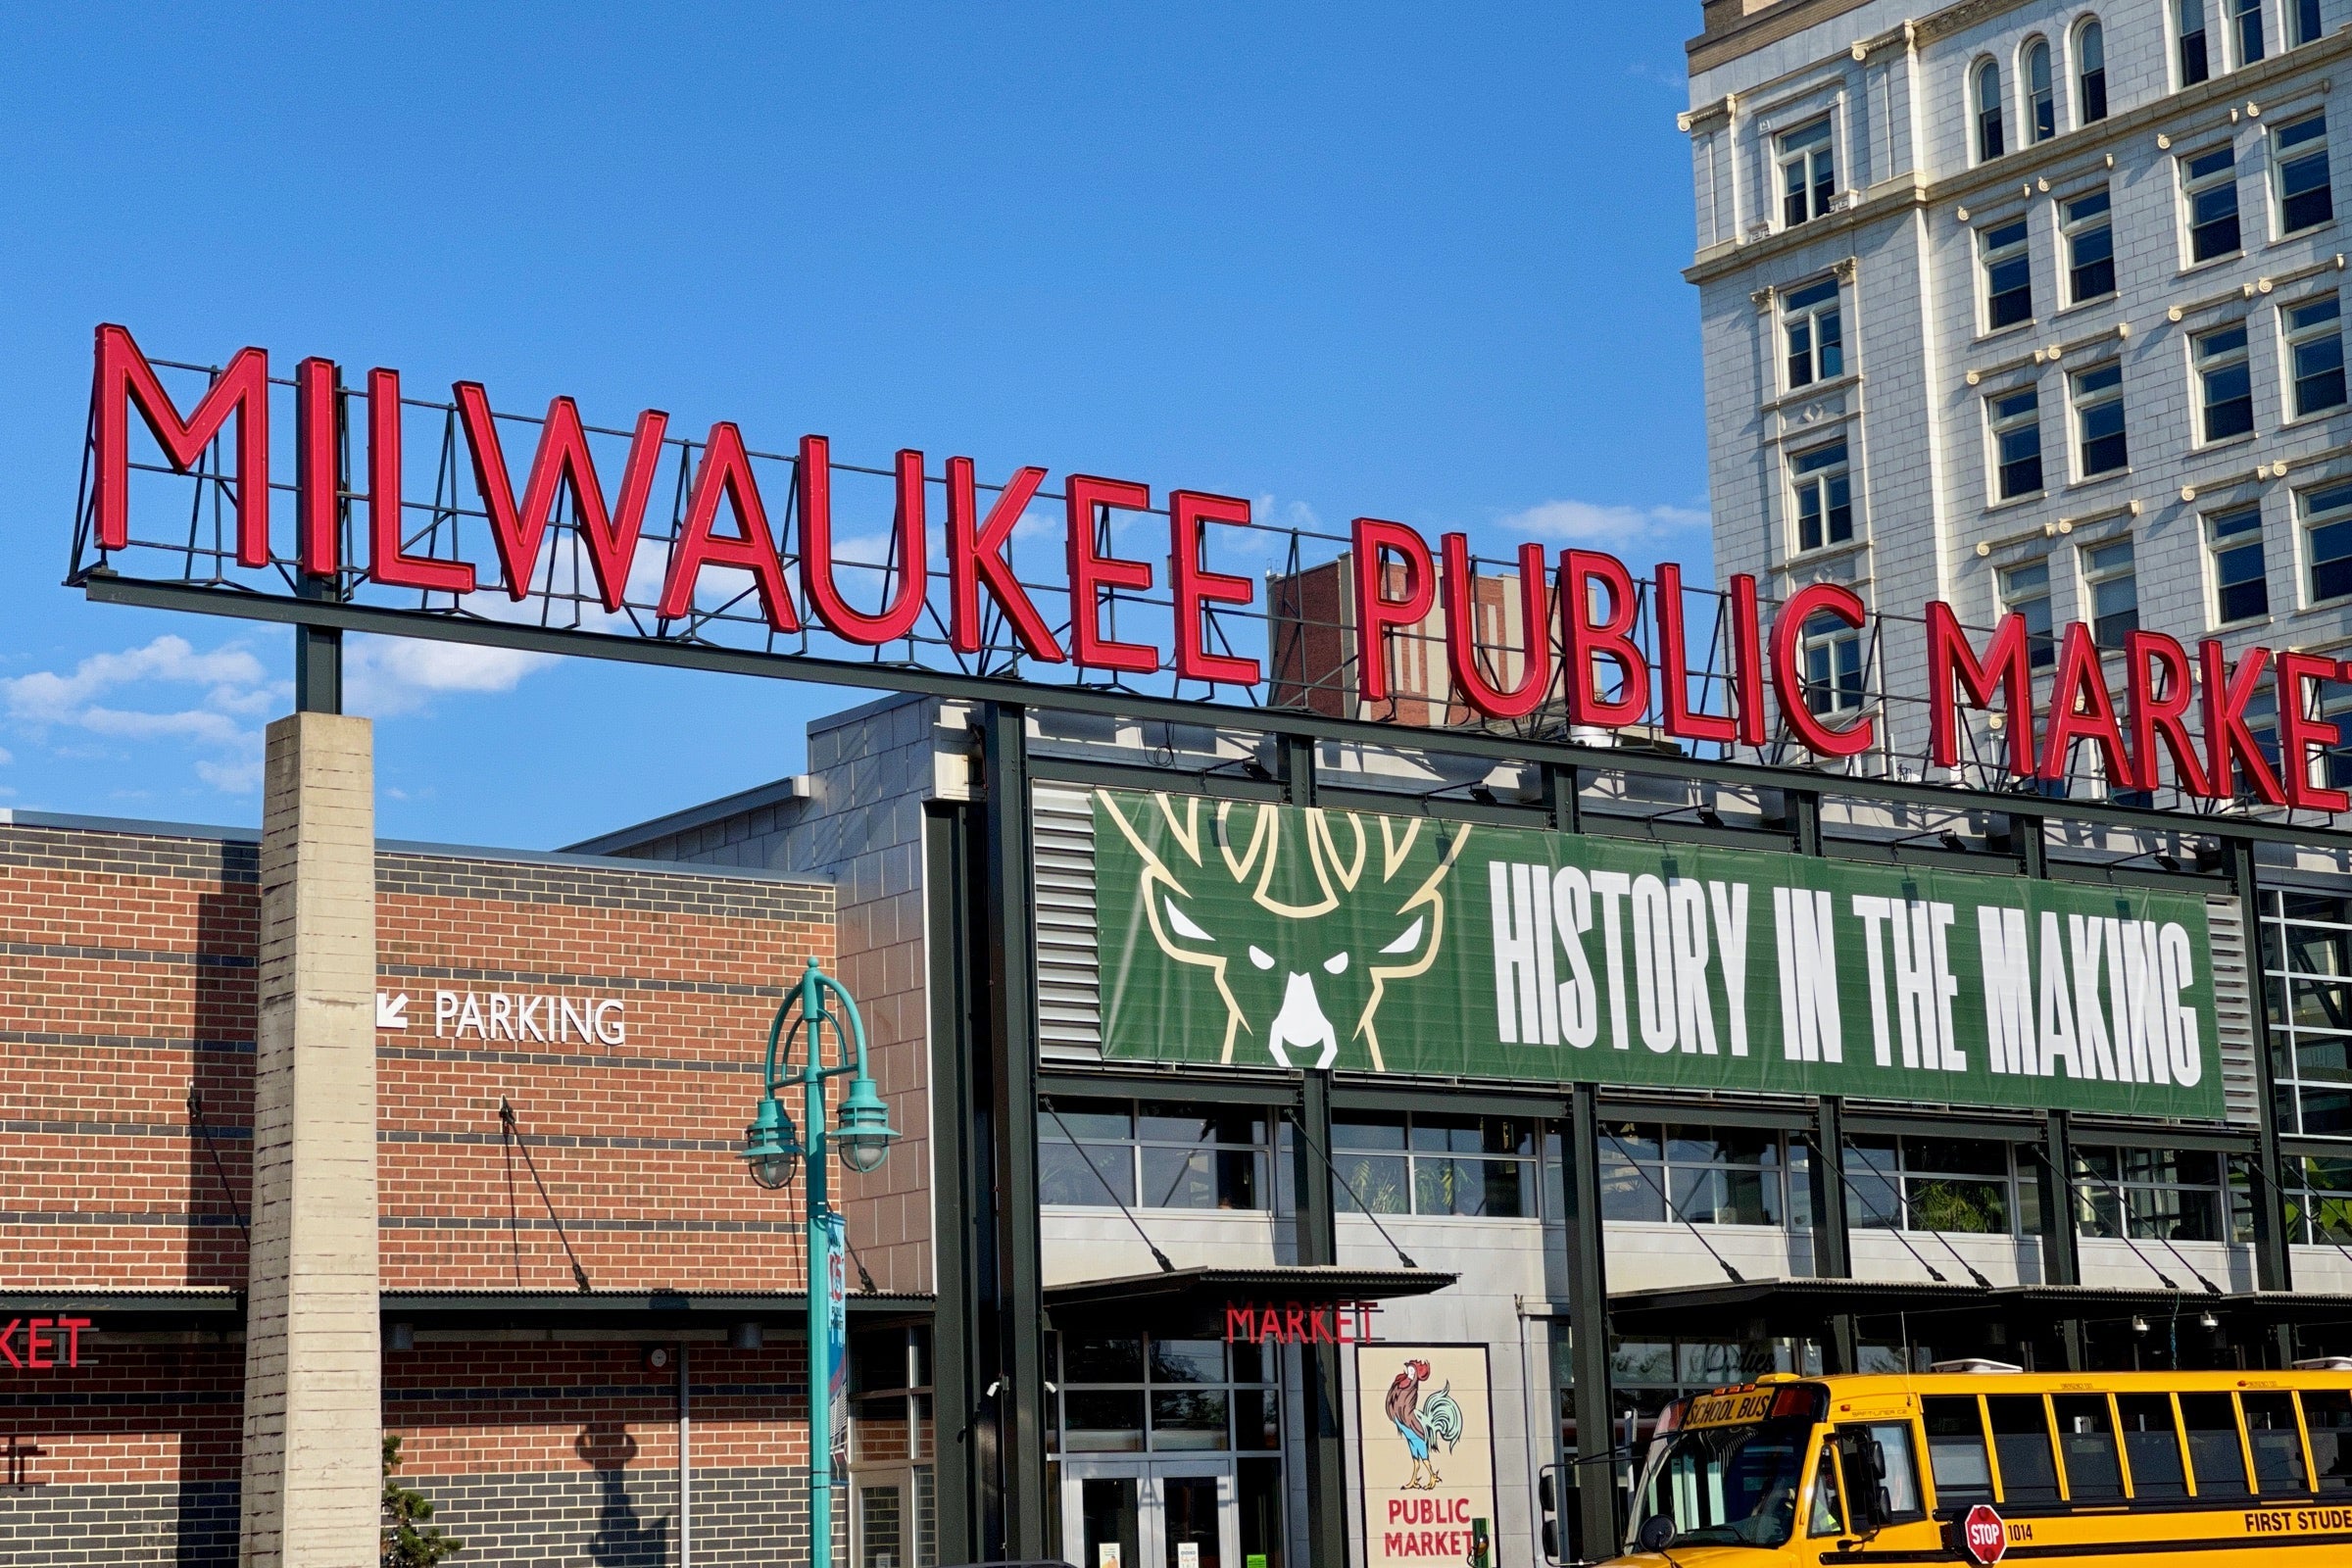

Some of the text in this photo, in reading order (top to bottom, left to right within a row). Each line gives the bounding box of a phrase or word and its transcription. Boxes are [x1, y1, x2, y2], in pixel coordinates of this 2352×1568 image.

[94, 322, 2352, 813] MILWAUKEE PUBLIC MARKE
[1489, 860, 2202, 1088] HISTORY IN THE MAKING
[435, 990, 625, 1046] PARKING
[1226, 1298, 1379, 1345] MARKET
[1686, 1395, 1770, 1426] SCHOOL BUS
[1388, 1497, 1471, 1525] PUBLIC
[2243, 1510, 2352, 1532] FIRST STUDE
[1970, 1523, 2000, 1545] STOP
[2008, 1523, 2034, 1542] 1014
